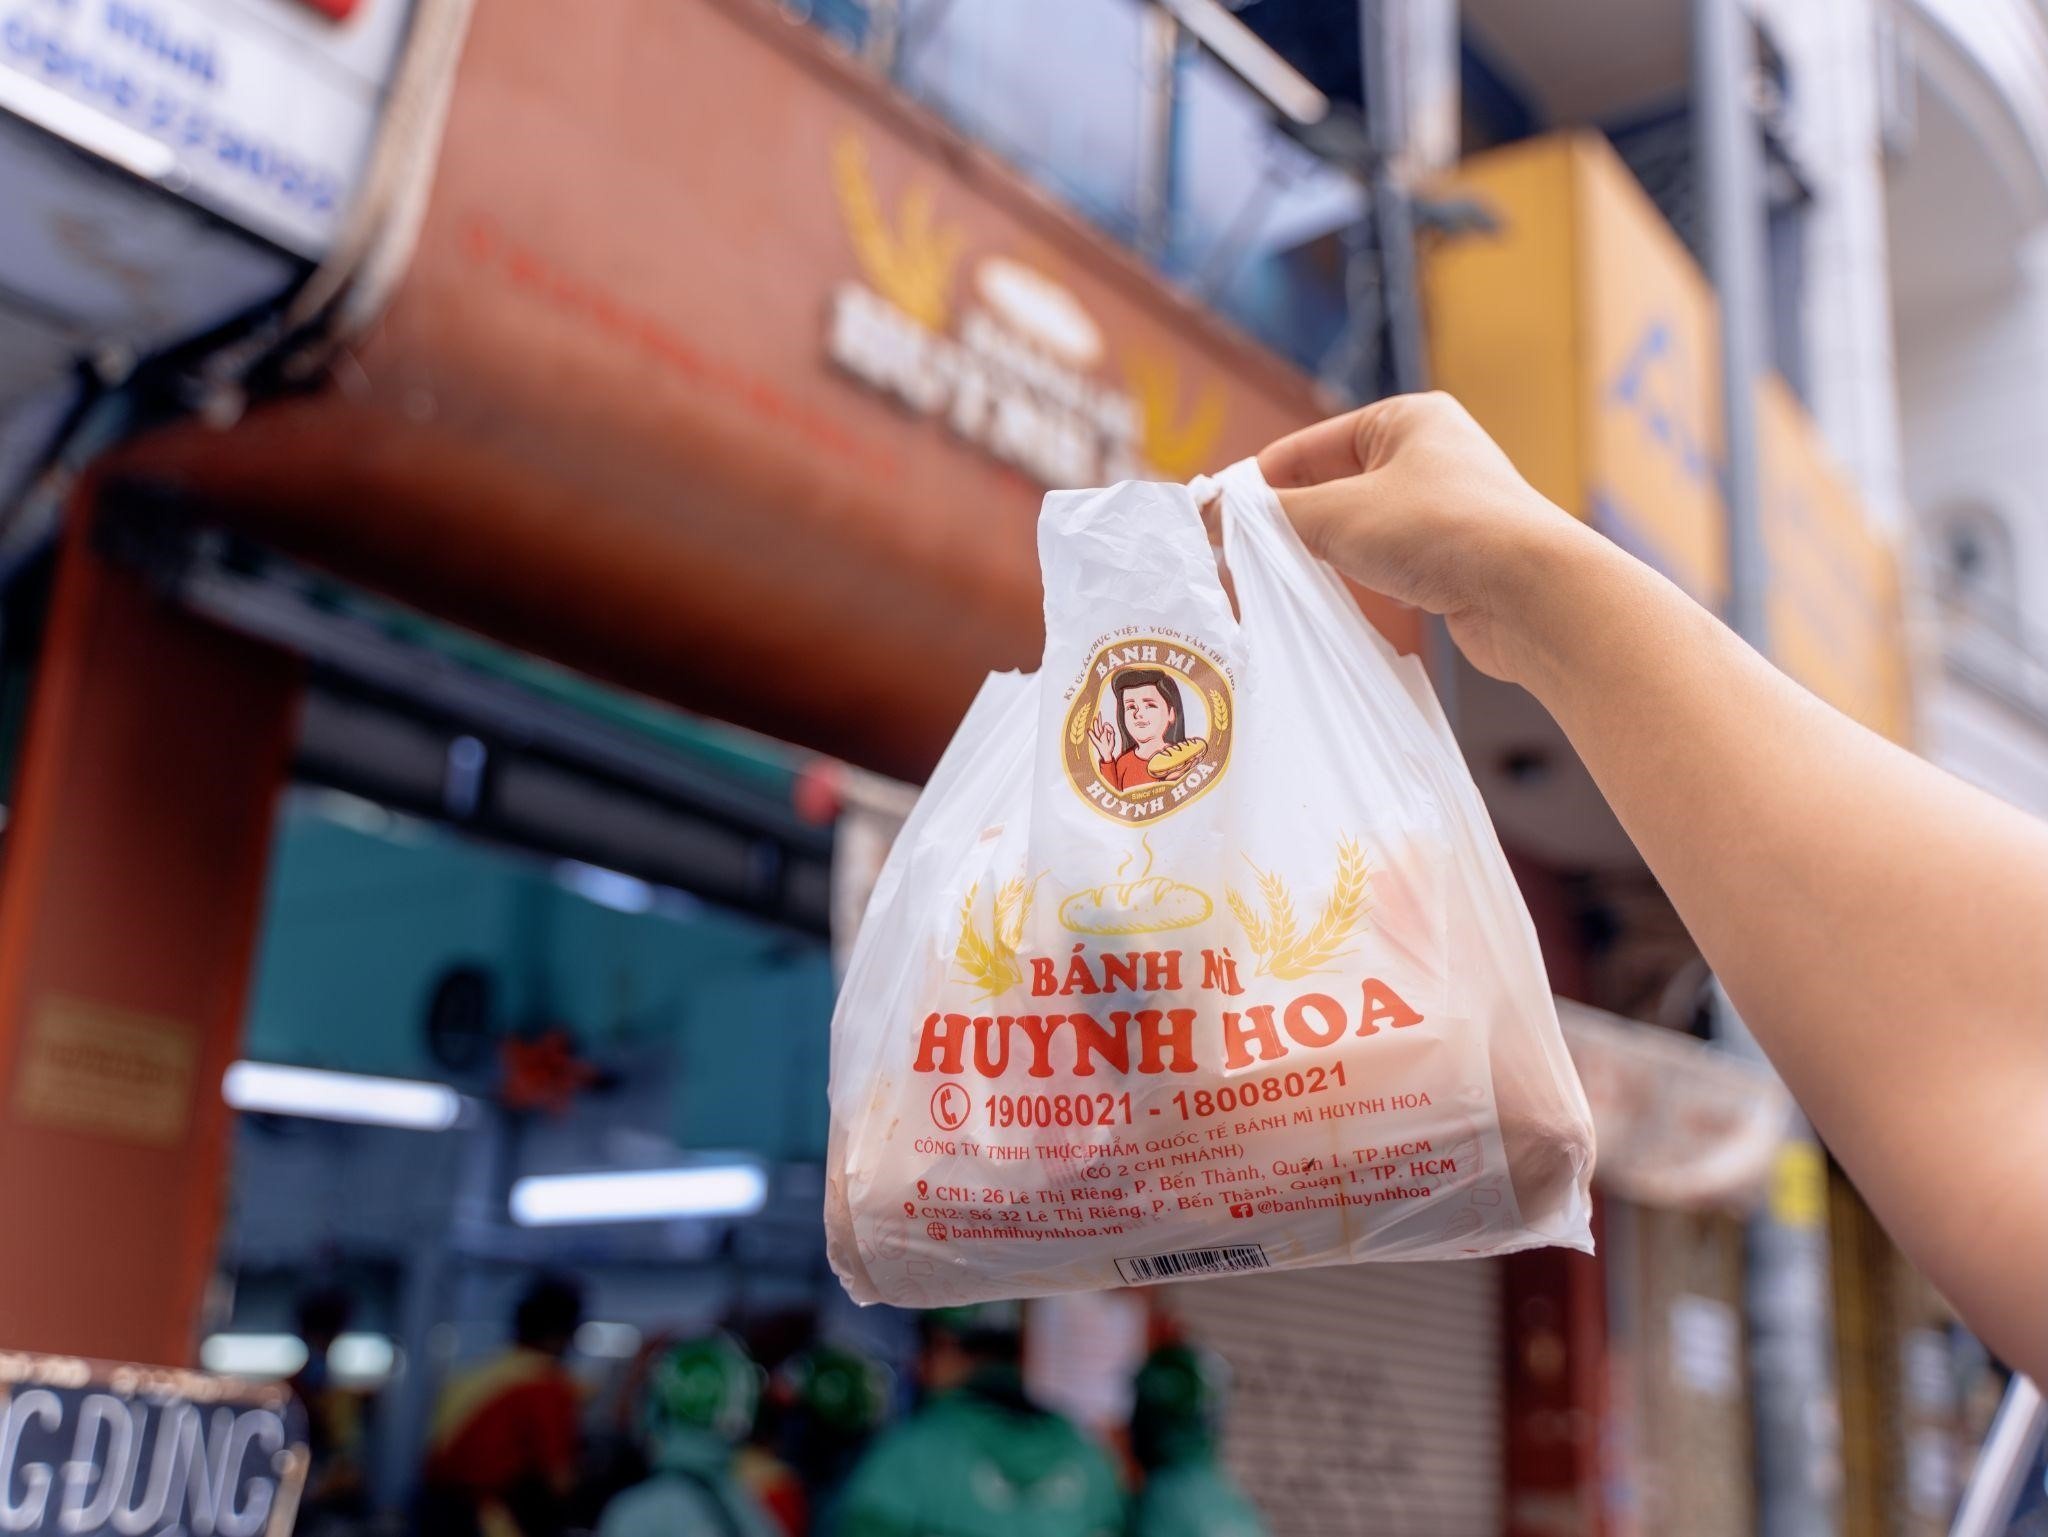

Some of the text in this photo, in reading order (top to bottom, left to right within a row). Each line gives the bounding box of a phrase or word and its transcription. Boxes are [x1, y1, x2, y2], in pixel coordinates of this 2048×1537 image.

[1096, 645, 1196, 679] BÁNH MÌ
[1086, 763, 1214, 817] HUYNH HOA
[1030, 943, 1245, 996] BÁNH MÌ
[913, 977, 1424, 1078] HUYNH HOA
[986, 1092, 1132, 1128] 19008021
[1172, 1061, 1345, 1121] 18008021
[914, 1092, 1432, 1162] CÔNG TY TNHH THỰC PHẨM QUỐC TẾ BÁNH MÌ HUYNH HOA
[936, 1186, 976, 1202] CN1:
[982, 1188, 1004, 1204] 26
[1009, 1191, 1031, 1205] Lê
[1036, 1190, 1065, 1205] Thị
[1071, 1187, 1128, 1201] Riêng,
[1134, 1180, 1153, 1194] P.
[1160, 1170, 1196, 1191] Bến
[1202, 1165, 1266, 1185] Thành,
[1272, 1157, 1323, 1177] Quận
[1330, 1154, 1347, 1169] 1,
[1118, 1165, 1129, 1177] 2
[1134, 1156, 1165, 1172] CHI
[1171, 1143, 1244, 1167] NHÁNH)
[921, 1207, 964, 1220] CN2:
[970, 1208, 992, 1221] Số
[999, 1210, 1021, 1222] 32
[1026, 1210, 1048, 1222] Lê
[1054, 1207, 1084, 1222] Thị
[1088, 1206, 1147, 1221] Riêng,
[1152, 1200, 1171, 1212] P.
[1177, 1192, 1214, 1210] Bến
[1349, 1170, 1365, 1185] 1,
[1371, 1165, 1403, 1181] TP.
[1409, 1158, 1457, 1177] HCM
[1257, 1185, 1431, 1214] @banhmihuynhhoa
[952, 1224, 1123, 1241] banhmihuynhhoa.vn
